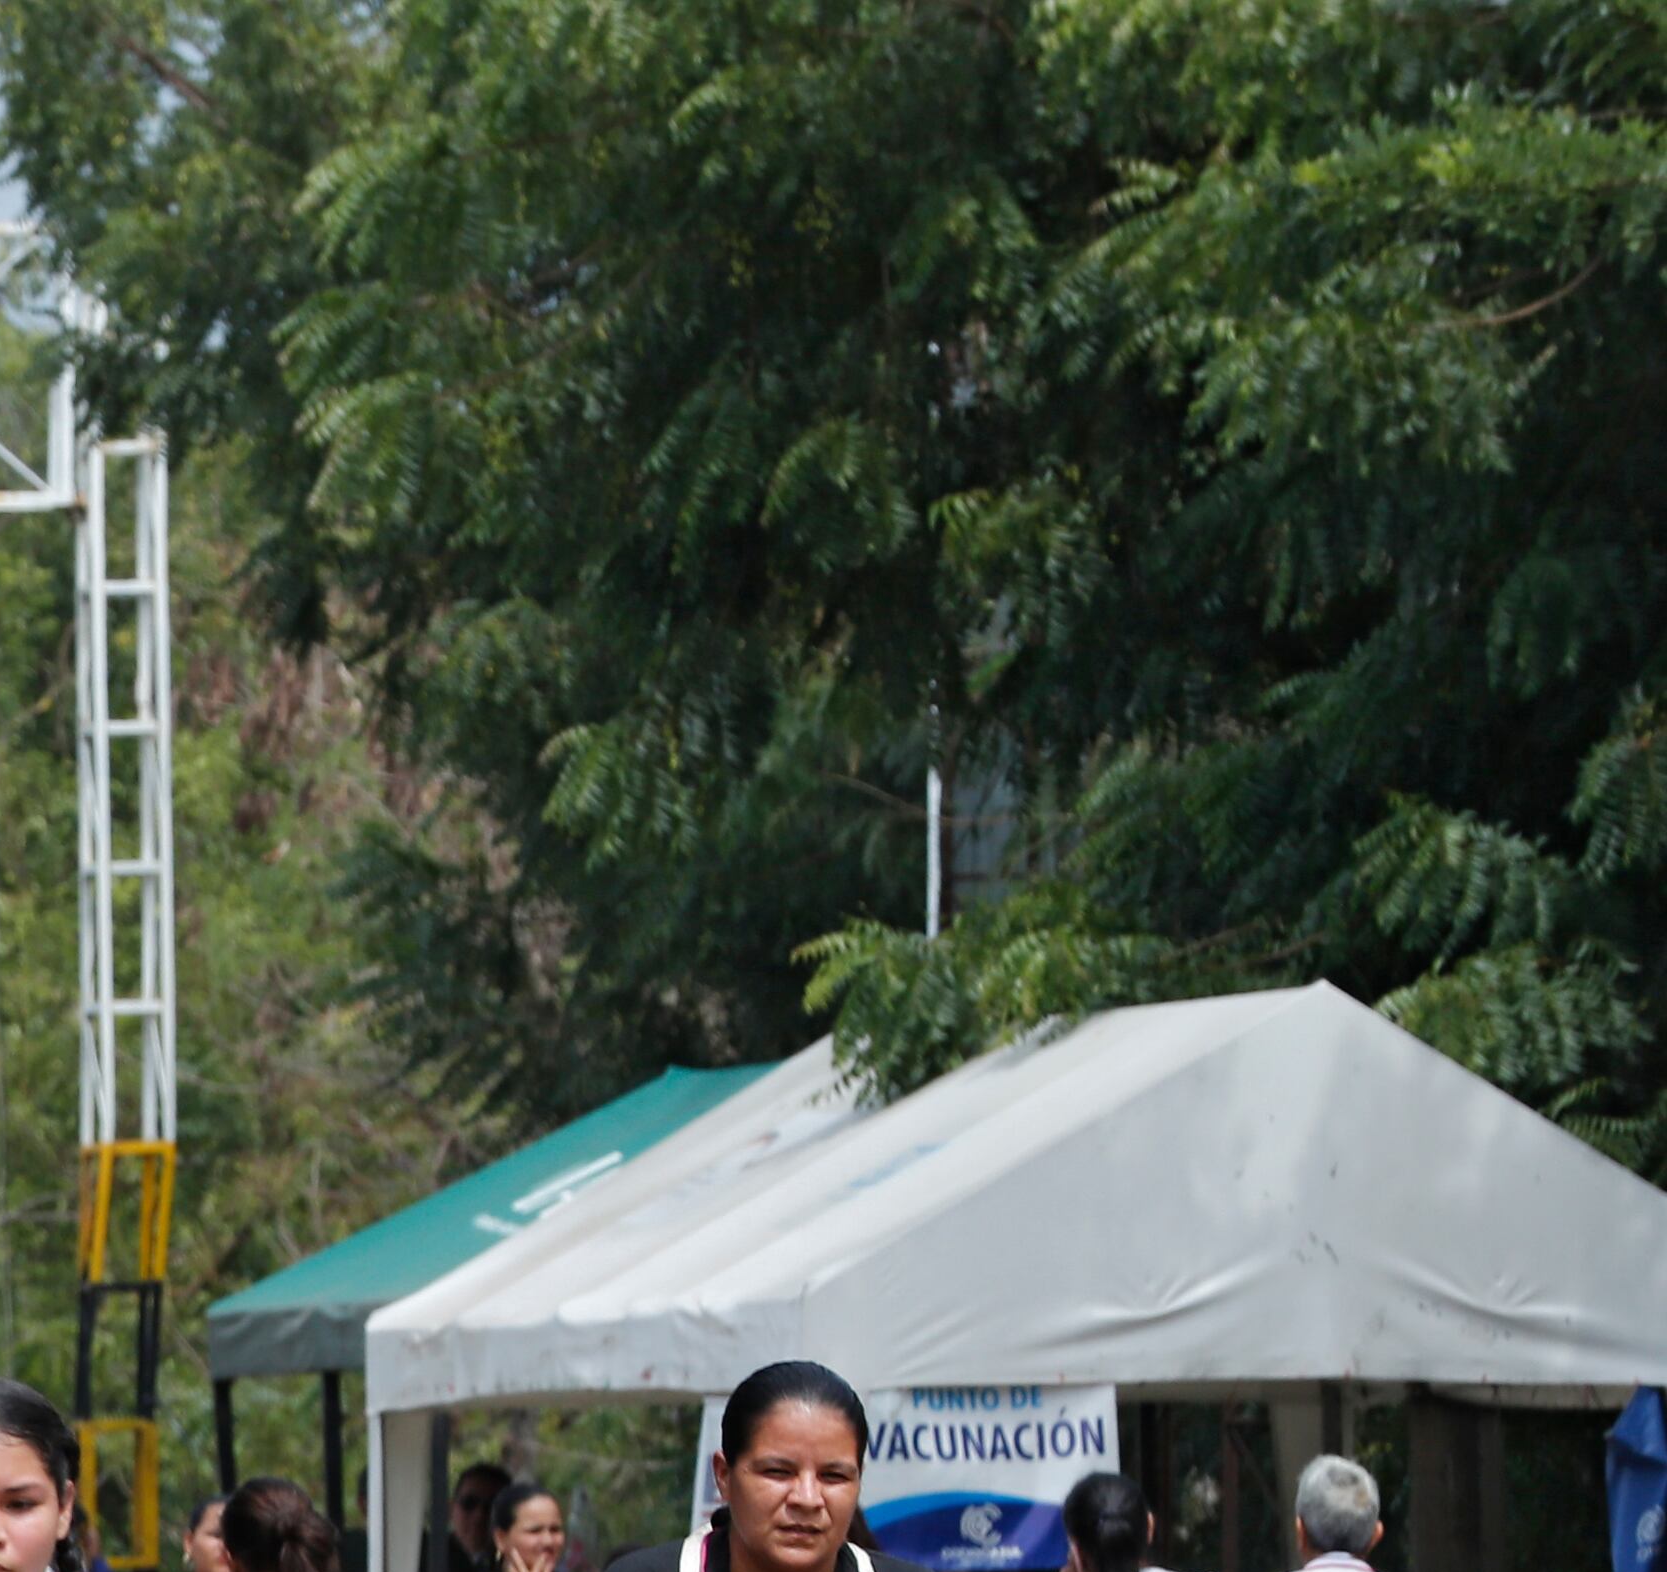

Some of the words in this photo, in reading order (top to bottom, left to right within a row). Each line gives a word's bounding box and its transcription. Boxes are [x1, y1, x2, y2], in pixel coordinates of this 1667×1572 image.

[911, 1384, 1000, 1412] PUNTO
[1010, 1383, 1045, 1410] DE
[866, 1407, 1107, 1462] VACUNACIÓN
